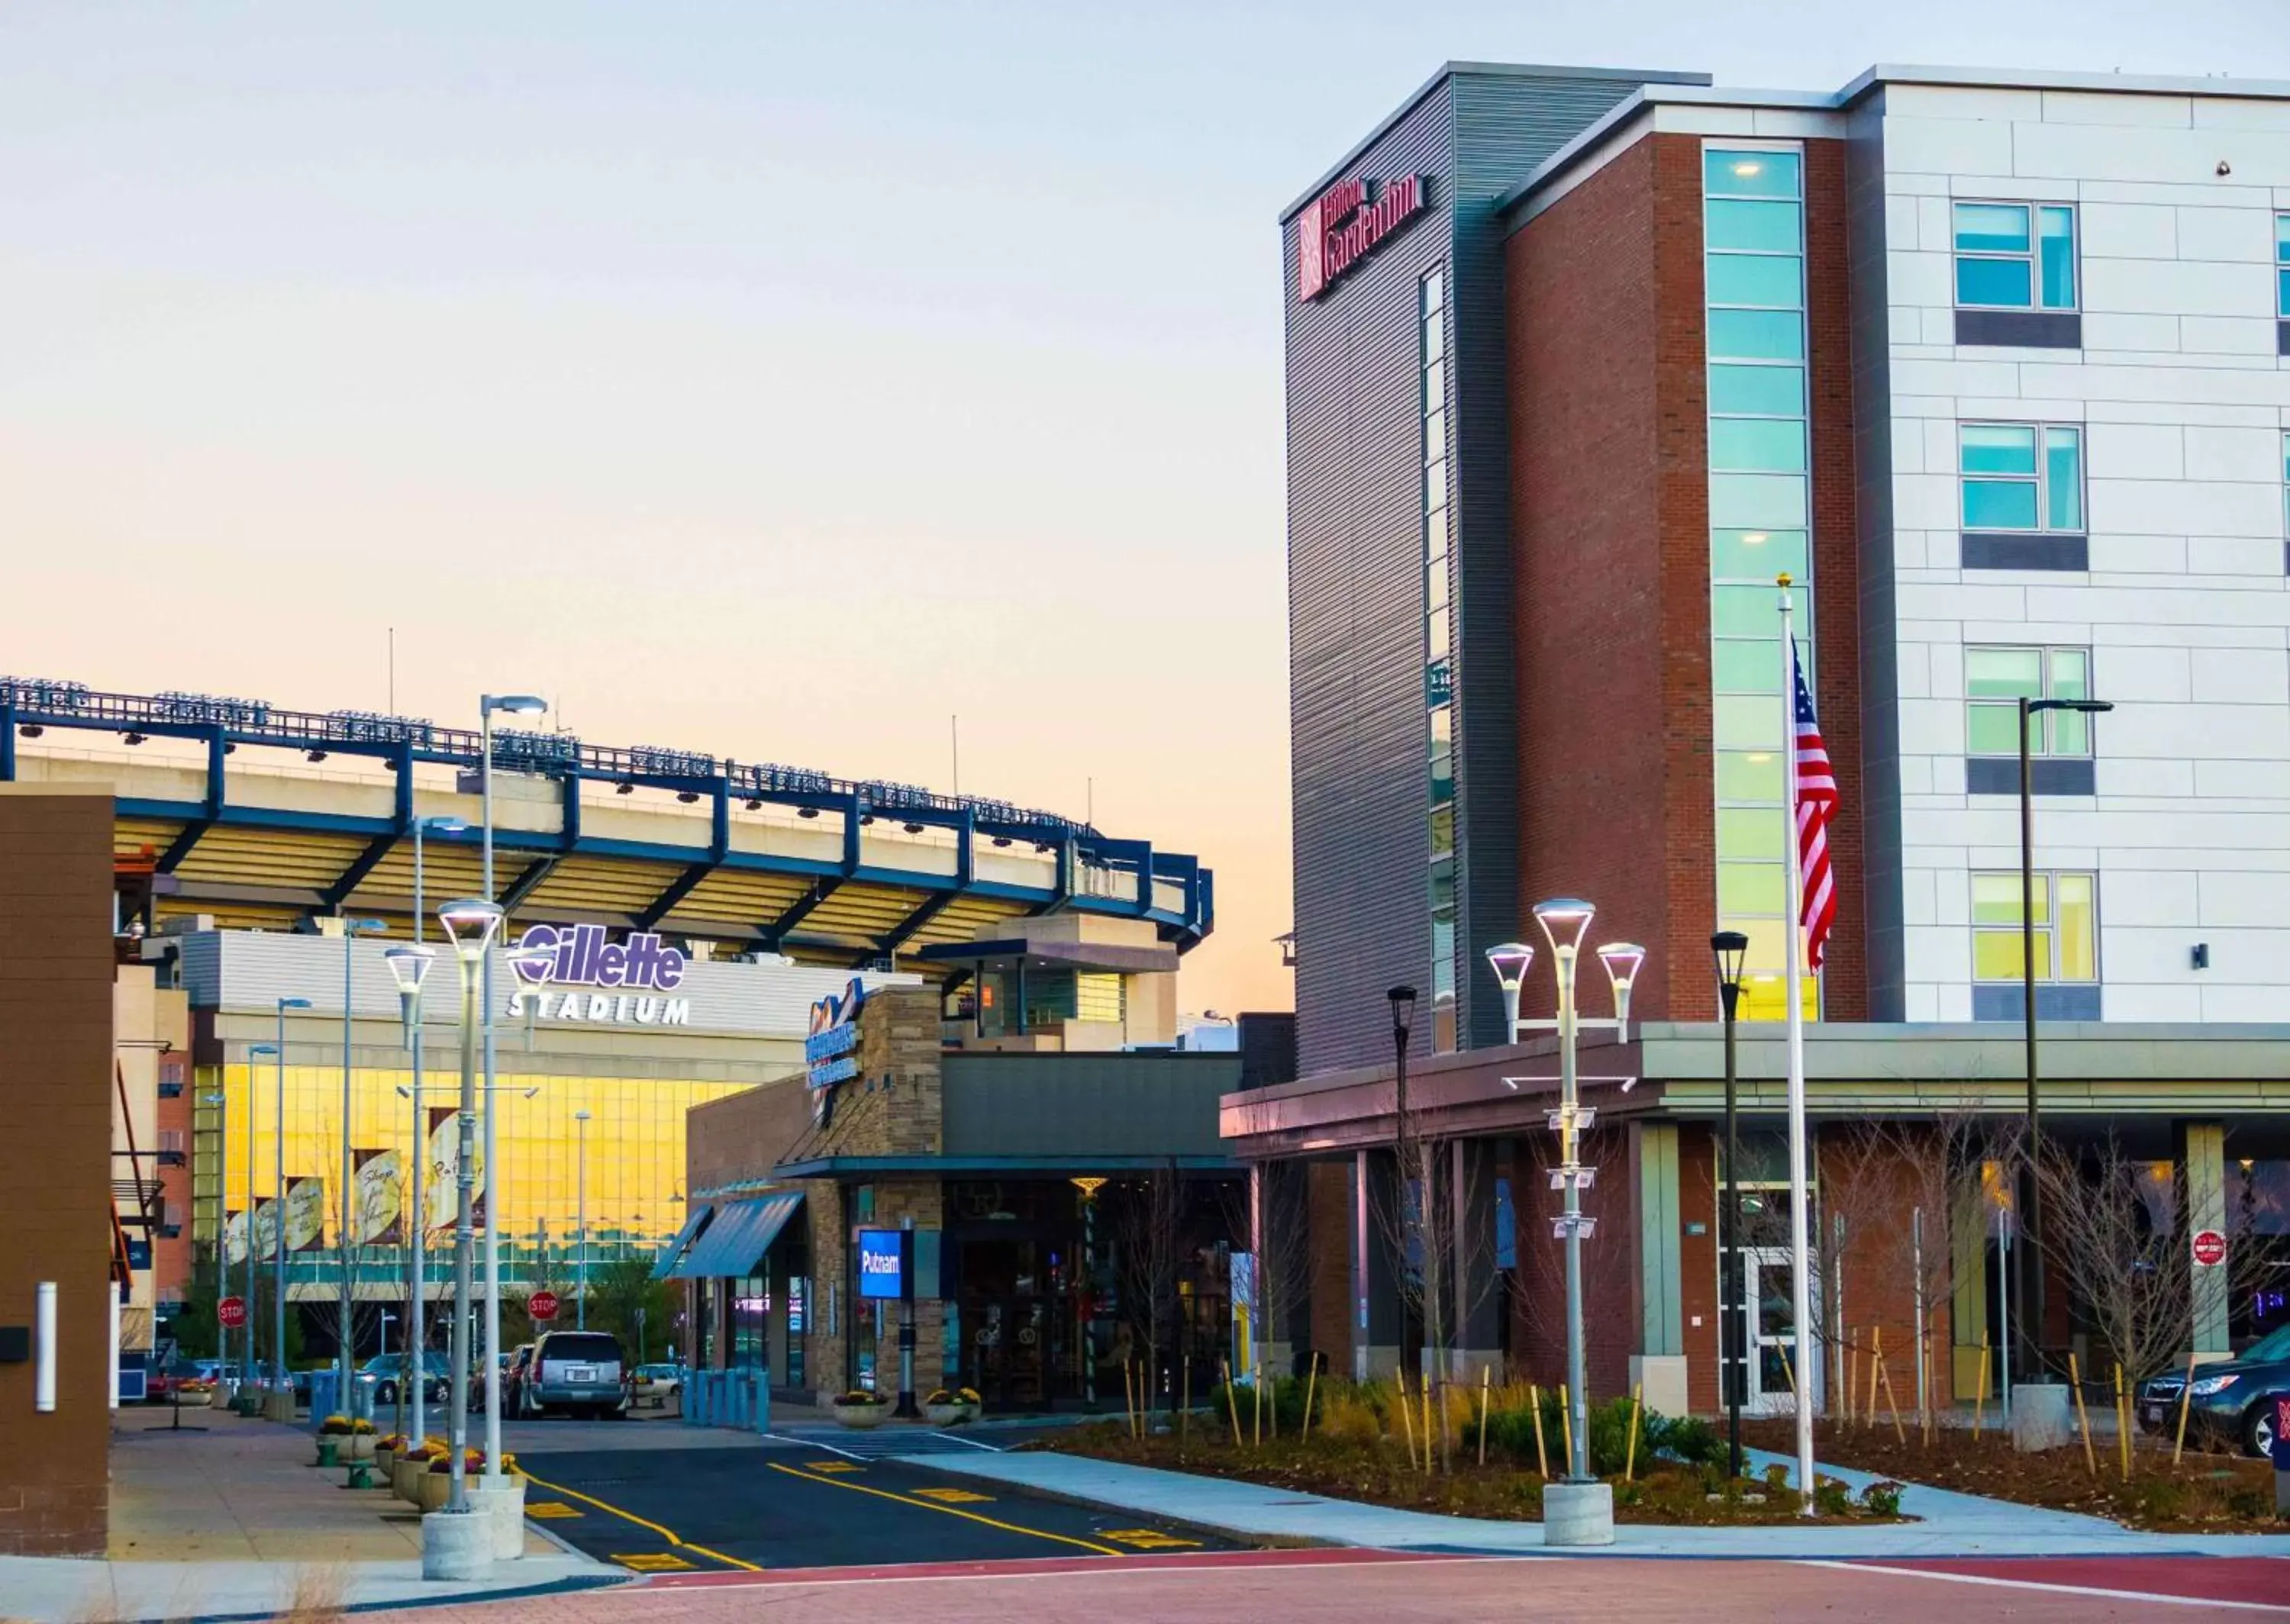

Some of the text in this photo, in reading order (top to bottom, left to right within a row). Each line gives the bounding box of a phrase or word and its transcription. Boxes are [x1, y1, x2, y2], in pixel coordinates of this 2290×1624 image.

[1324, 177, 1360, 230] Hilton
[1324, 172, 1417, 280] Garden Inn
[519, 924, 684, 991] Gillette
[507, 992, 689, 1026] STADIUM
[862, 1249, 899, 1274] Putnam
[531, 1300, 556, 1311] STOP
